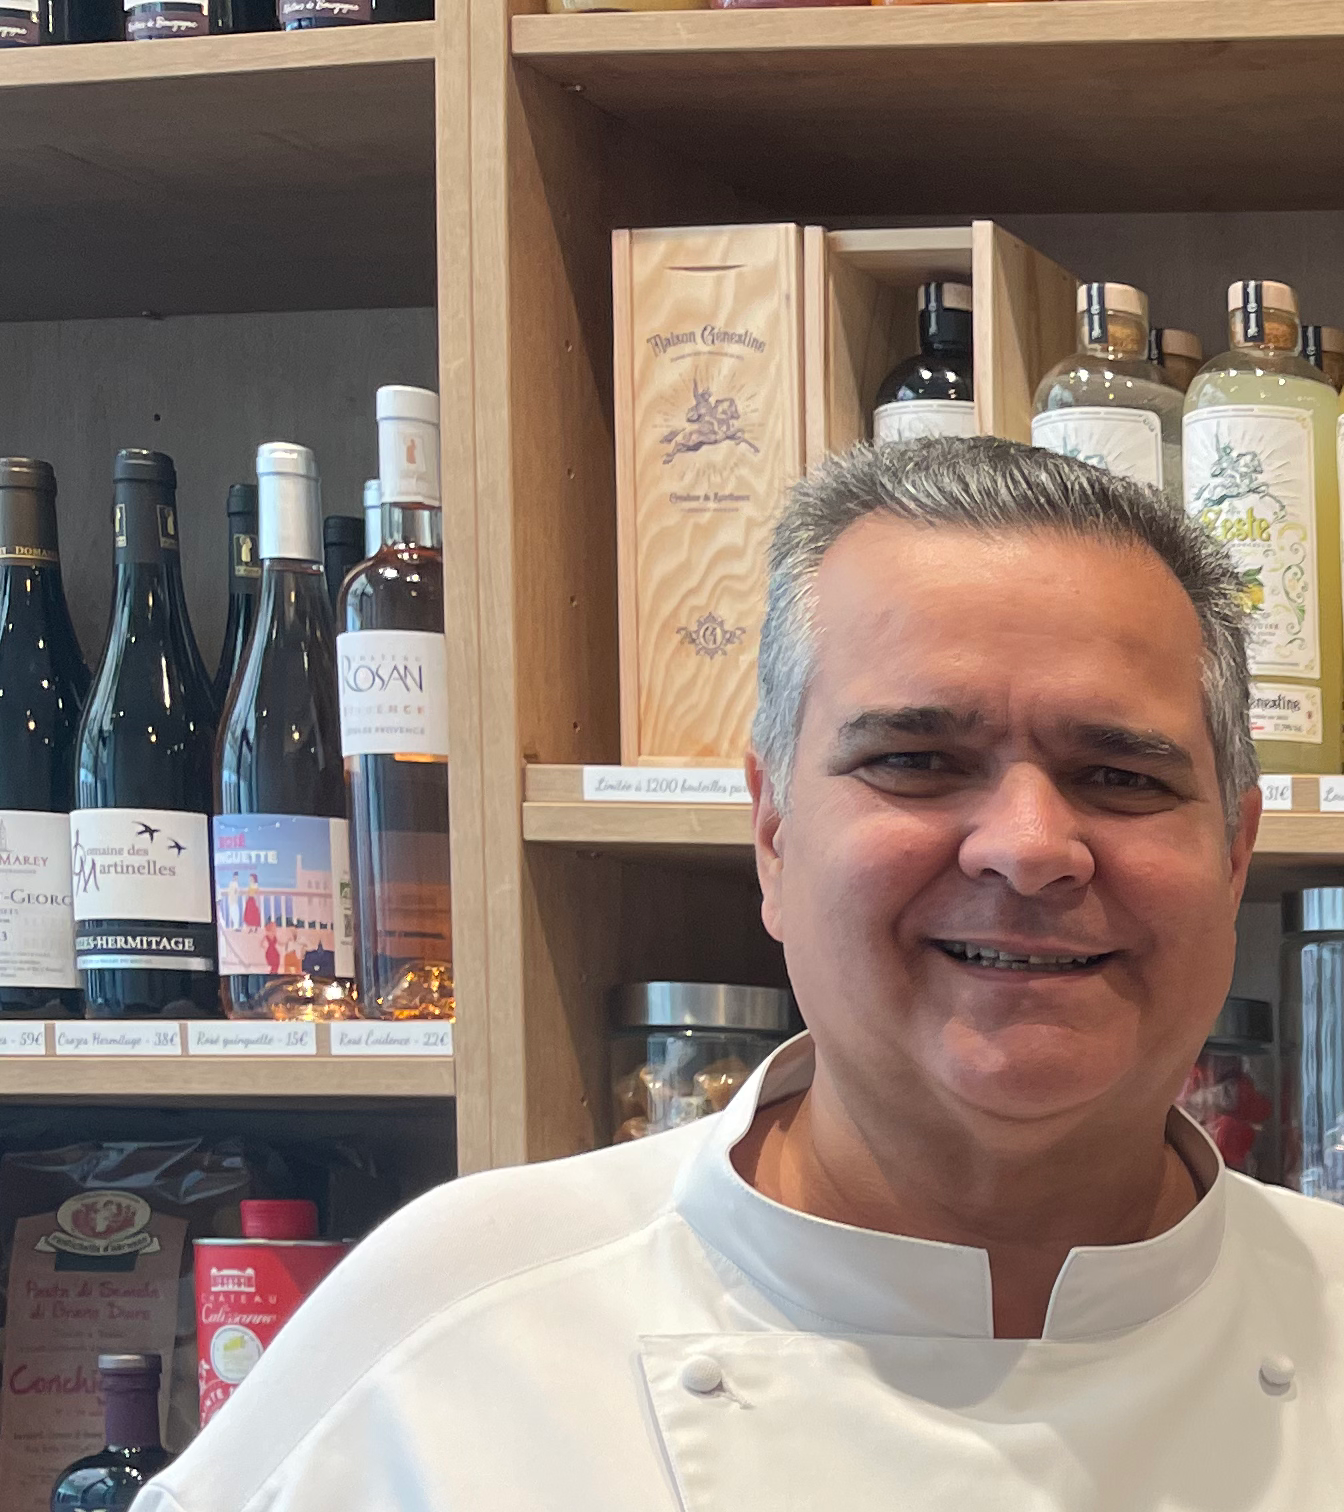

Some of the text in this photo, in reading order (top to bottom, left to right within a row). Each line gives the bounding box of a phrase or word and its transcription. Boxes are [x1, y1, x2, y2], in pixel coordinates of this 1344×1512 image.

[647, 324, 766, 357] Maison Génestine
[342, 655, 423, 694] ROSAN
[646, 778, 679, 793] 1200
[1265, 785, 1290, 801] 31€
[127, 844, 149, 856] des
[79, 857, 176, 893] Martinelles
[19, 1032, 42, 1046] 59€
[92, 1032, 141, 1049] Hermitage
[154, 1032, 178, 1046] 38€
[197, 1031, 219, 1045] Rosé
[286, 1032, 308, 1046] 15€
[339, 1032, 362, 1046] Rosé
[423, 1032, 449, 1046] 22€
